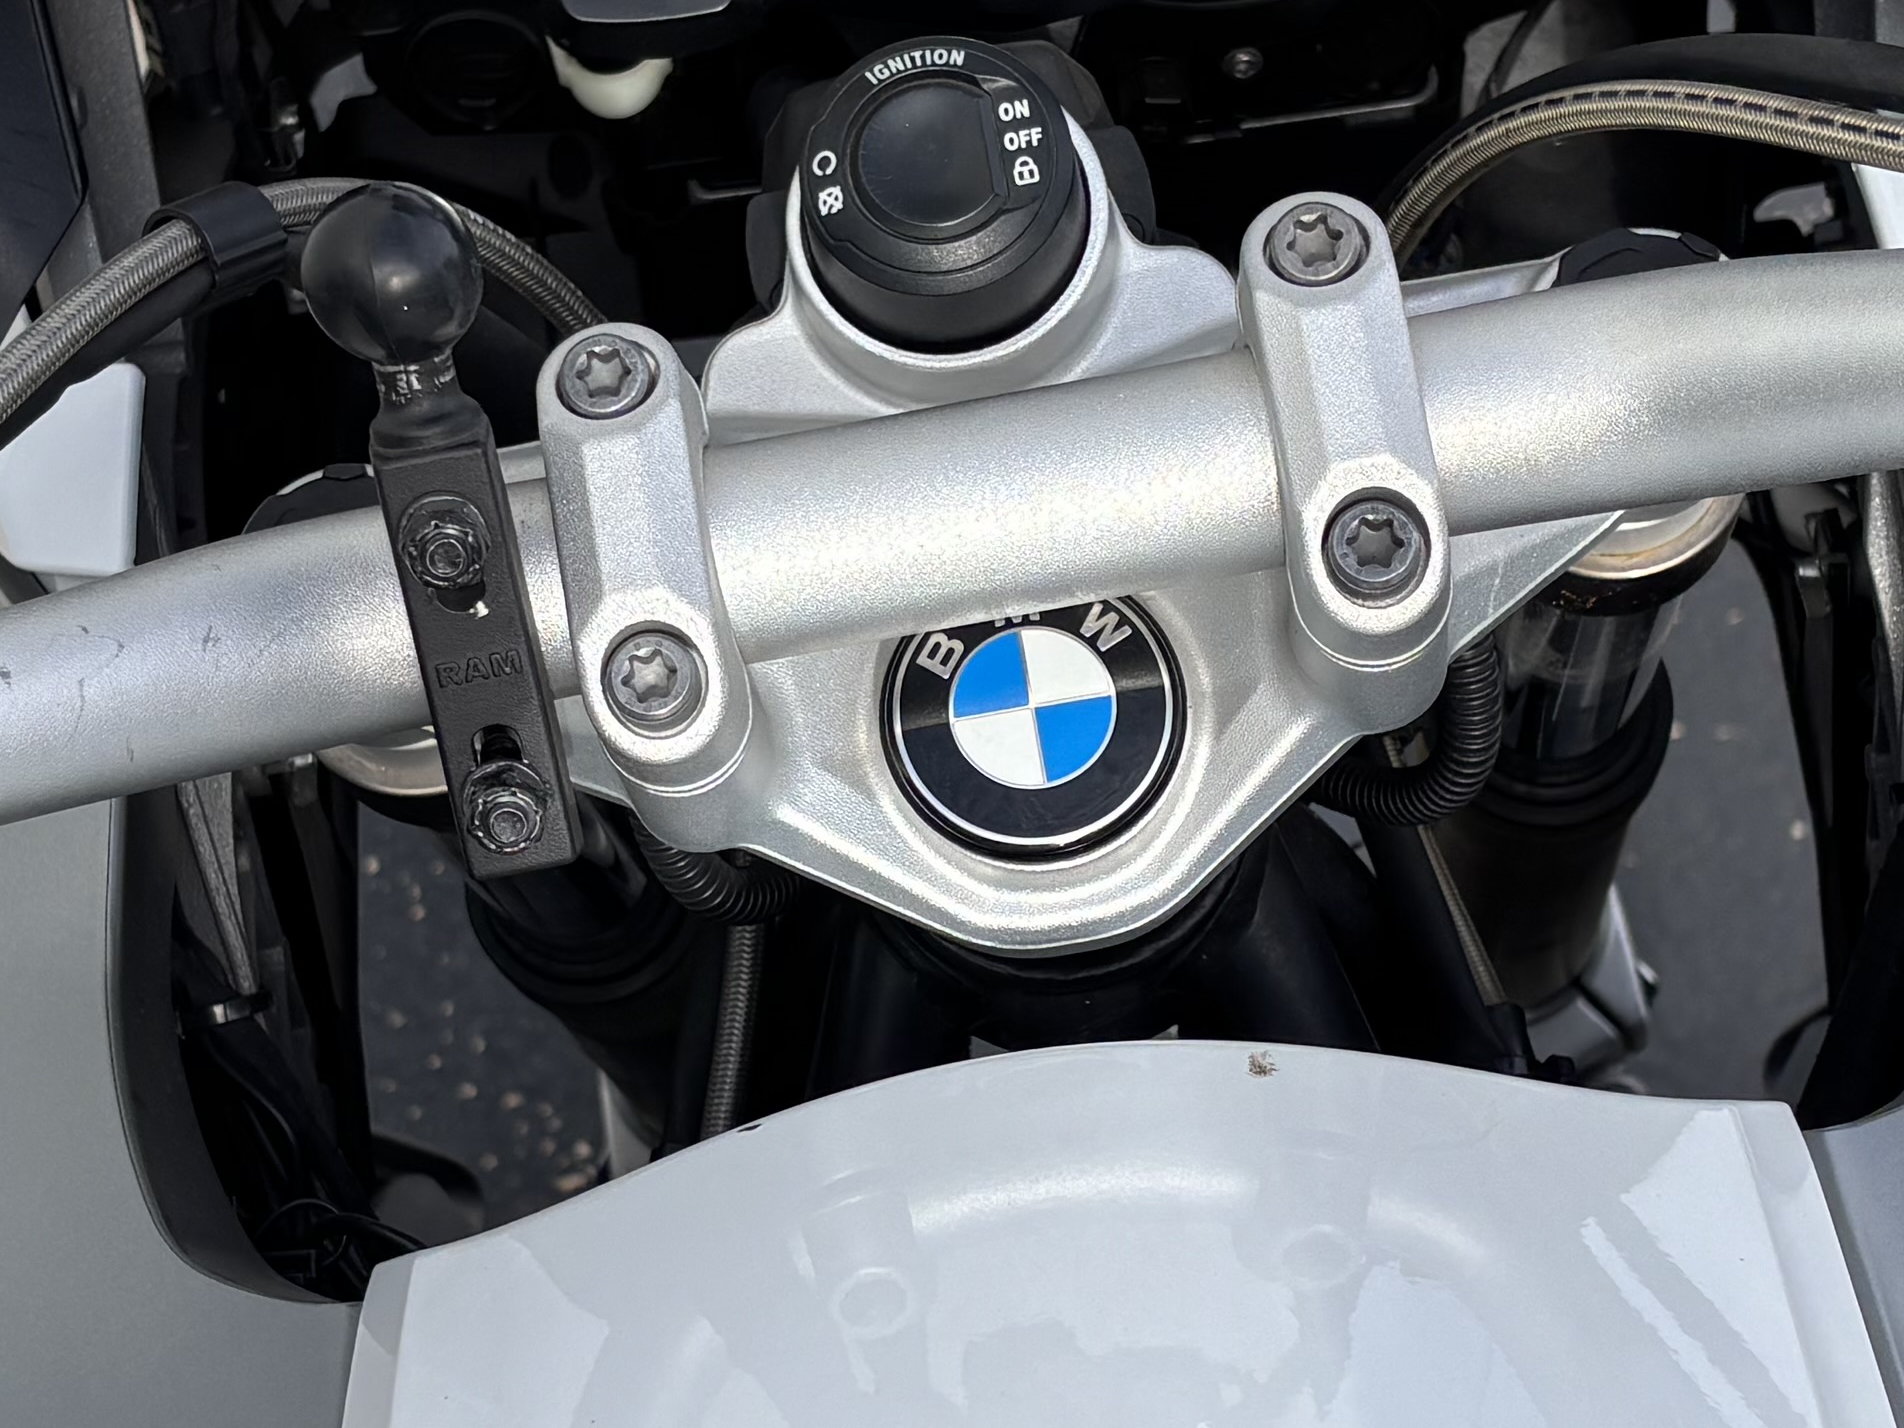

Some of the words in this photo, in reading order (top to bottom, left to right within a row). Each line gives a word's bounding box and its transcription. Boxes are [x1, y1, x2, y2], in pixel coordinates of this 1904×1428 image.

[864, 47, 966, 86] IGNITION
[997, 98, 1031, 123] ON
[1003, 127, 1043, 152] OFF
[915, 601, 1133, 680] BW
[435, 648, 524, 689] RAM
